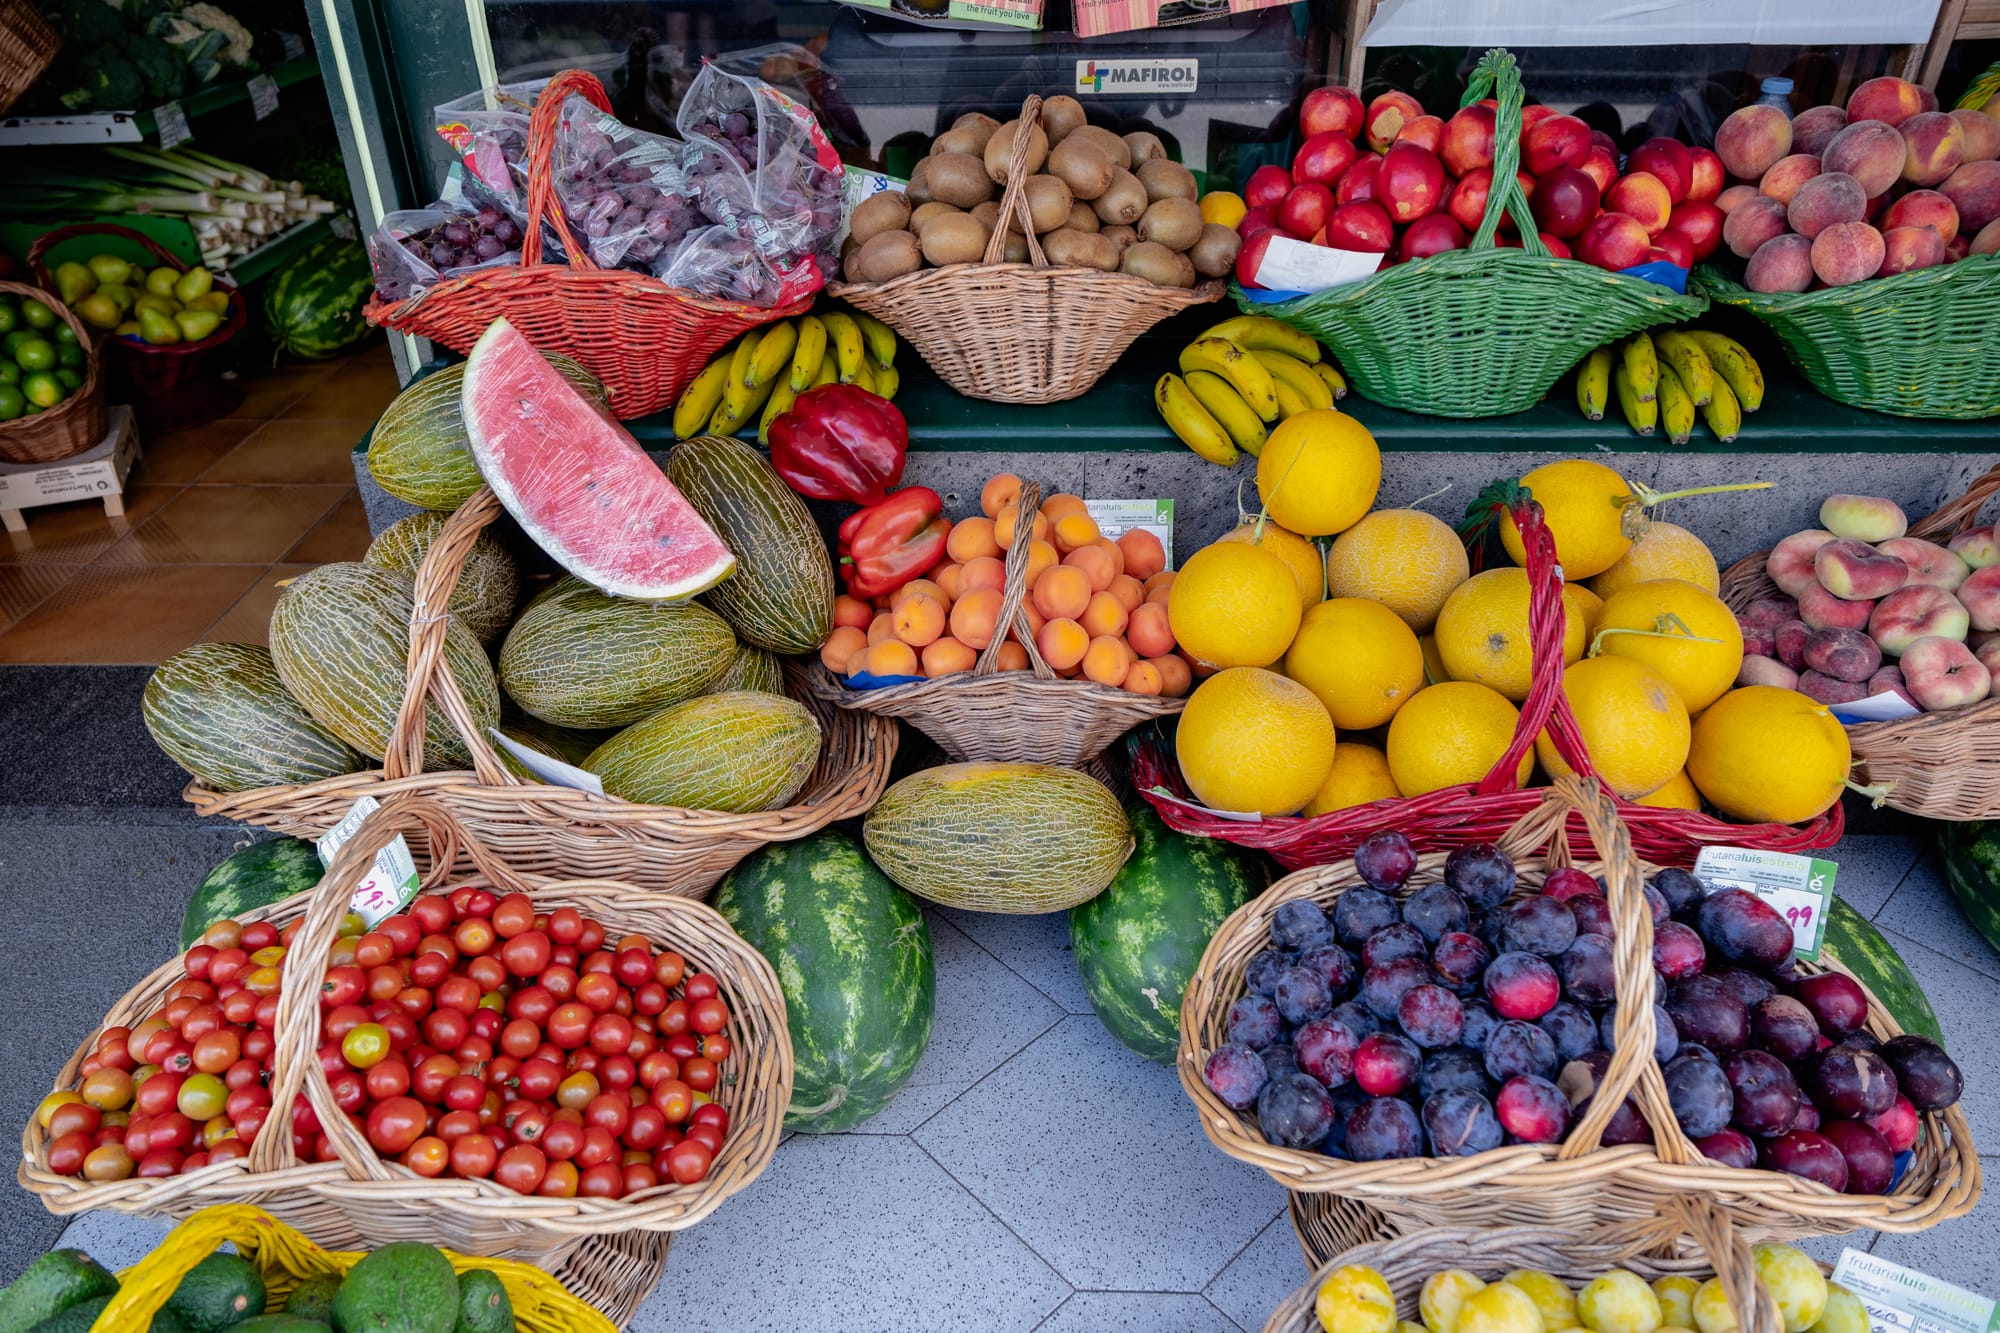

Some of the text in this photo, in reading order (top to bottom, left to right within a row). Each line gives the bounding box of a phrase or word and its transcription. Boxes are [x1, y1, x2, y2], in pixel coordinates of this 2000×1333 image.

[966, 4, 1030, 20] the fruit you love
[1111, 67, 1195, 83] MAFIROL
